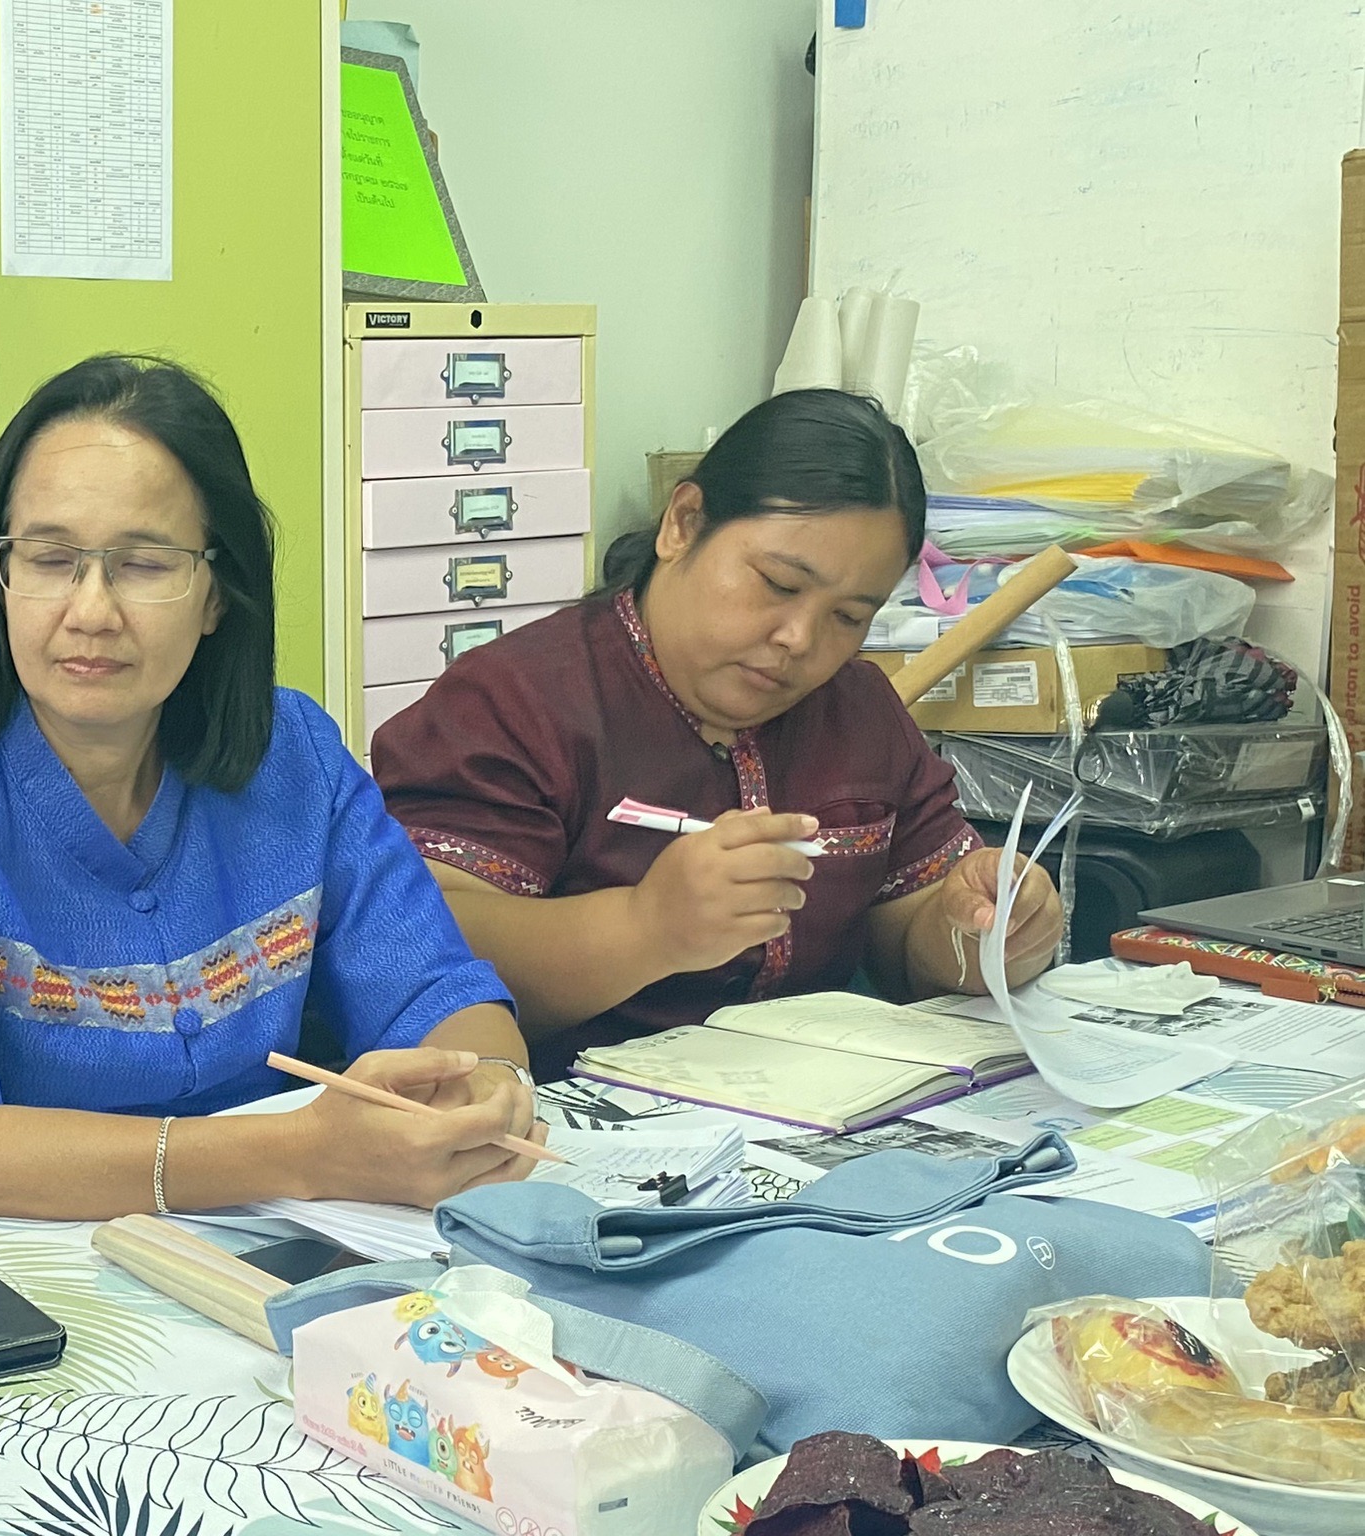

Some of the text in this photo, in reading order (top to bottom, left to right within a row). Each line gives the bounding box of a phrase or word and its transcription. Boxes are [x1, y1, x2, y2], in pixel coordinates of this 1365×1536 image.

[368, 314, 408, 326] VICTORY
[1347, 585, 1361, 637] avoid
[1347, 642, 1359, 661] to
[383, 1459, 406, 1477] LITTLE
[446, 1490, 482, 1514] FRIENDS
